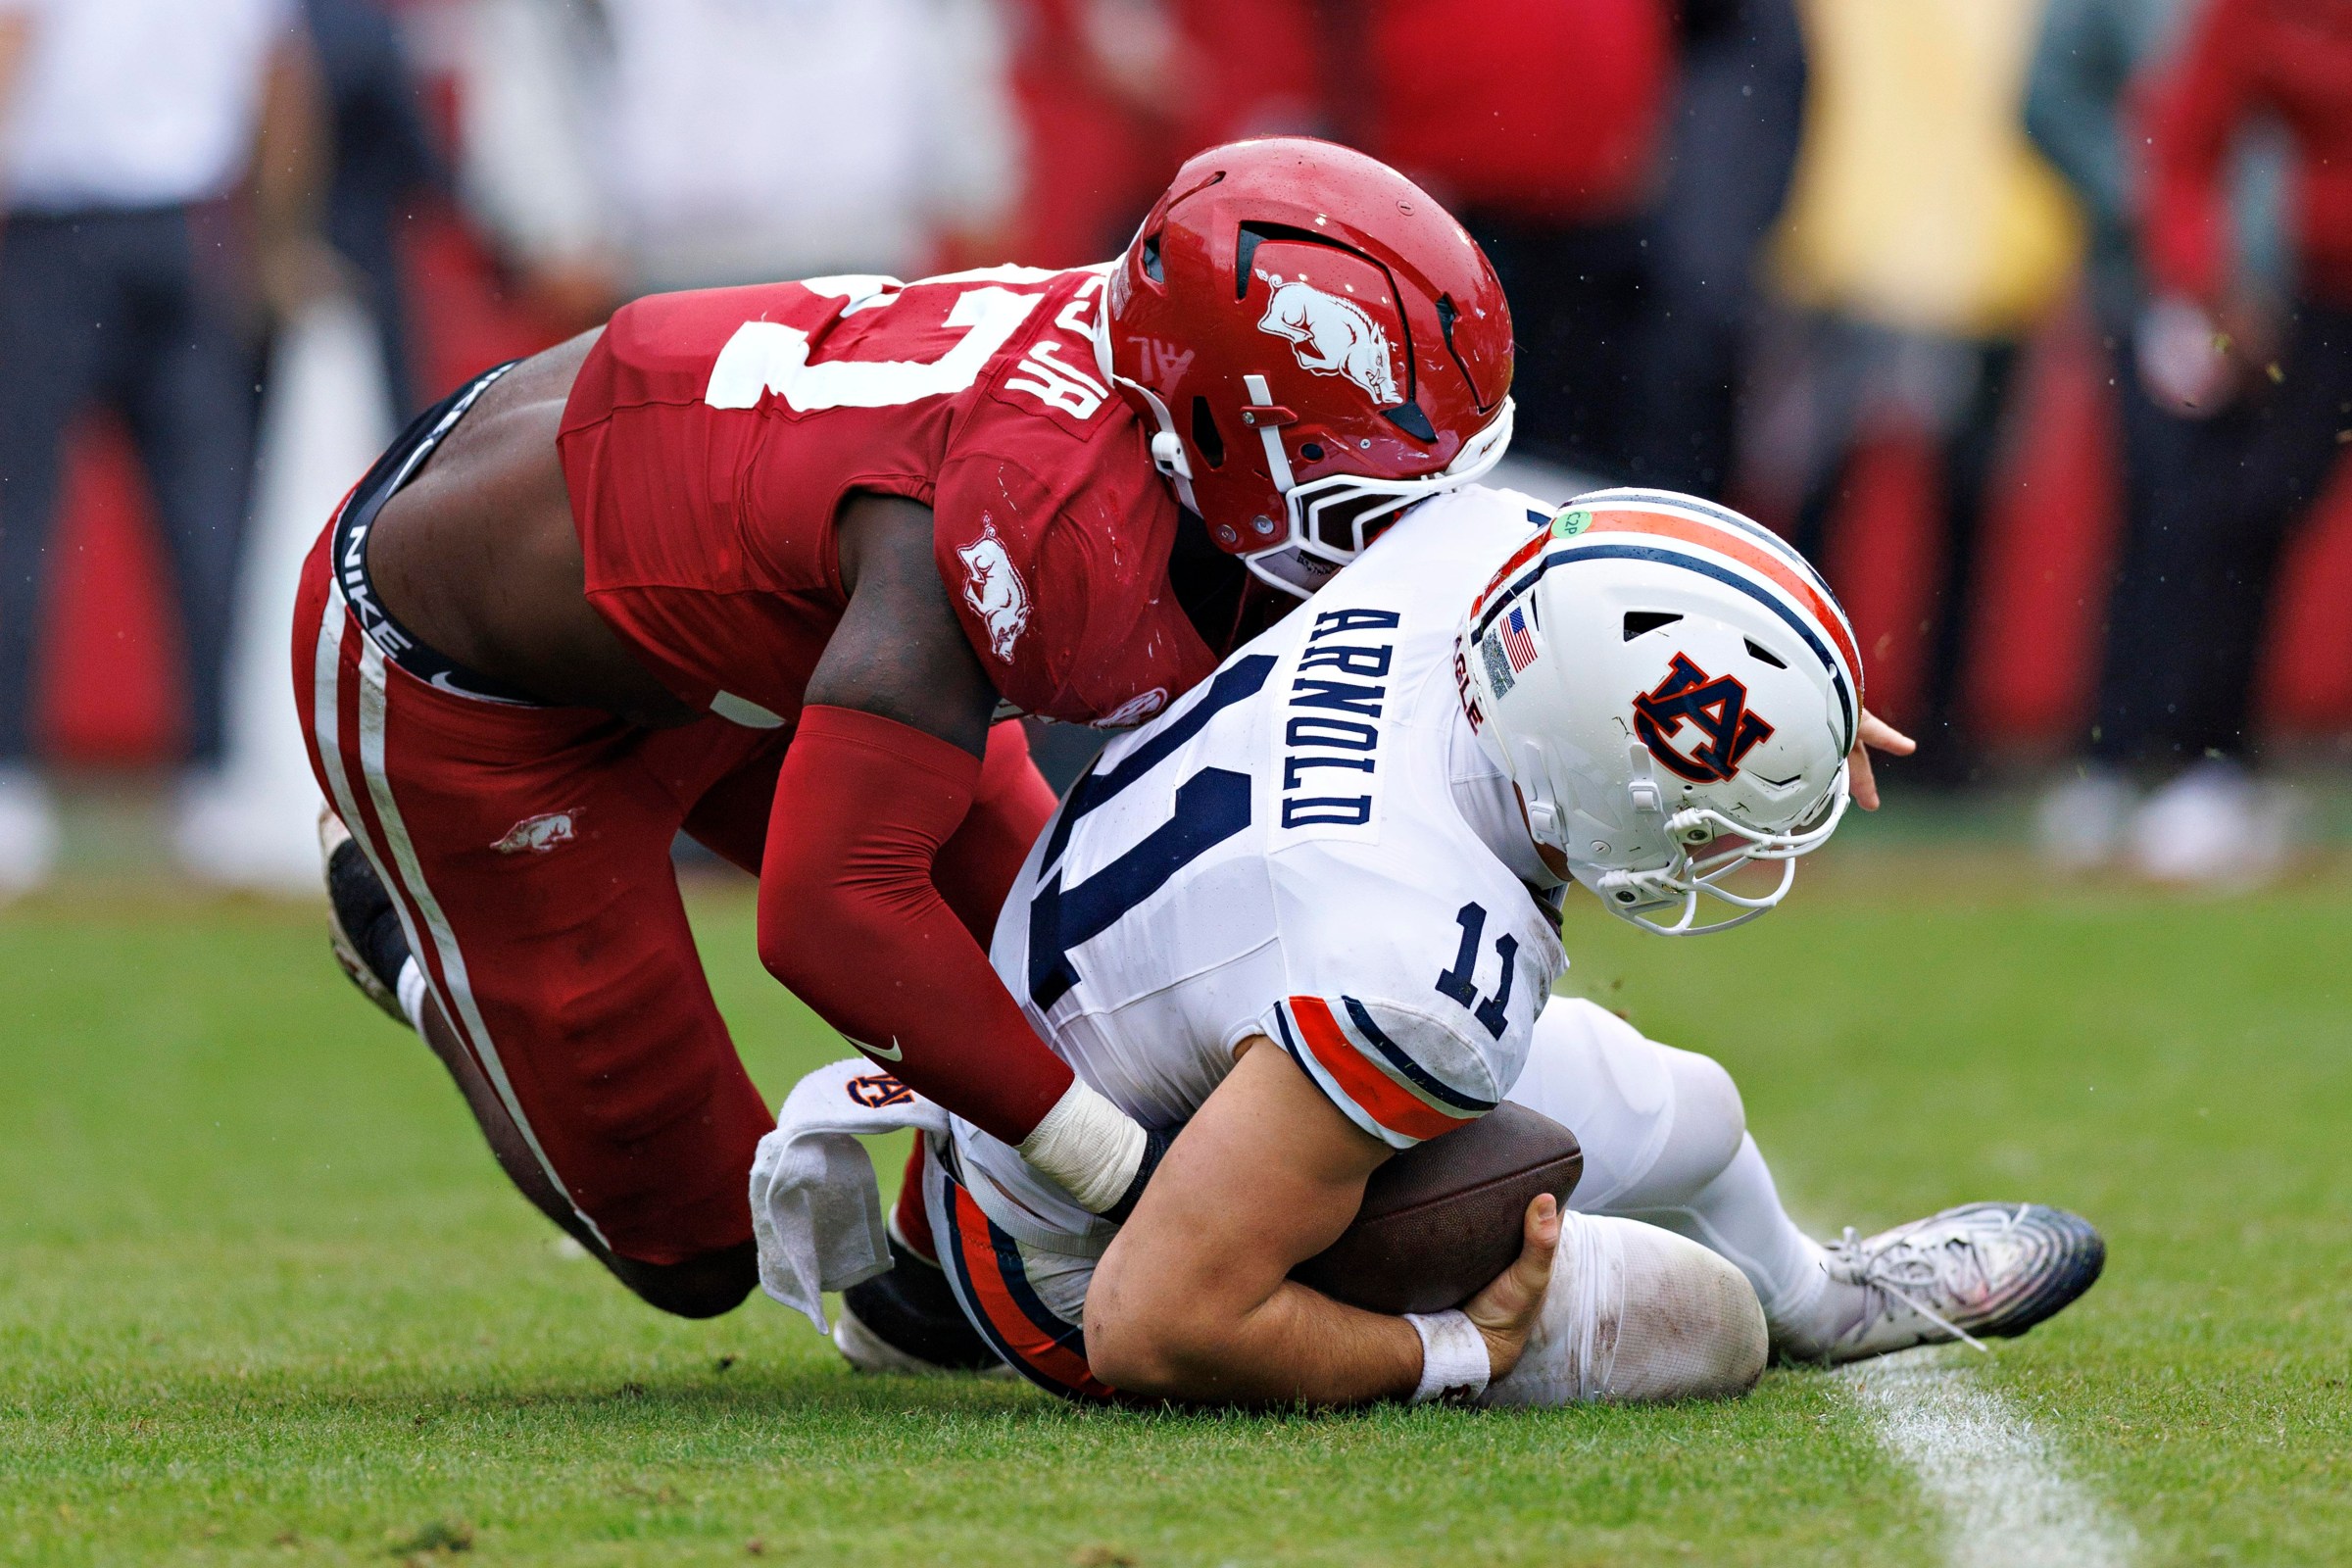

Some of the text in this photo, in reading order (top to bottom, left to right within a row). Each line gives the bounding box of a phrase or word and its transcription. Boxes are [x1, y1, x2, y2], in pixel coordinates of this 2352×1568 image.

[1004, 339, 1109, 420] JR
[344, 524, 413, 660] NIKE
[1564, 512, 1582, 535] C2P
[1281, 608, 1401, 830] ARNOLD
[1029, 654, 1279, 1013] 11
[1434, 901, 1519, 1041] 11
